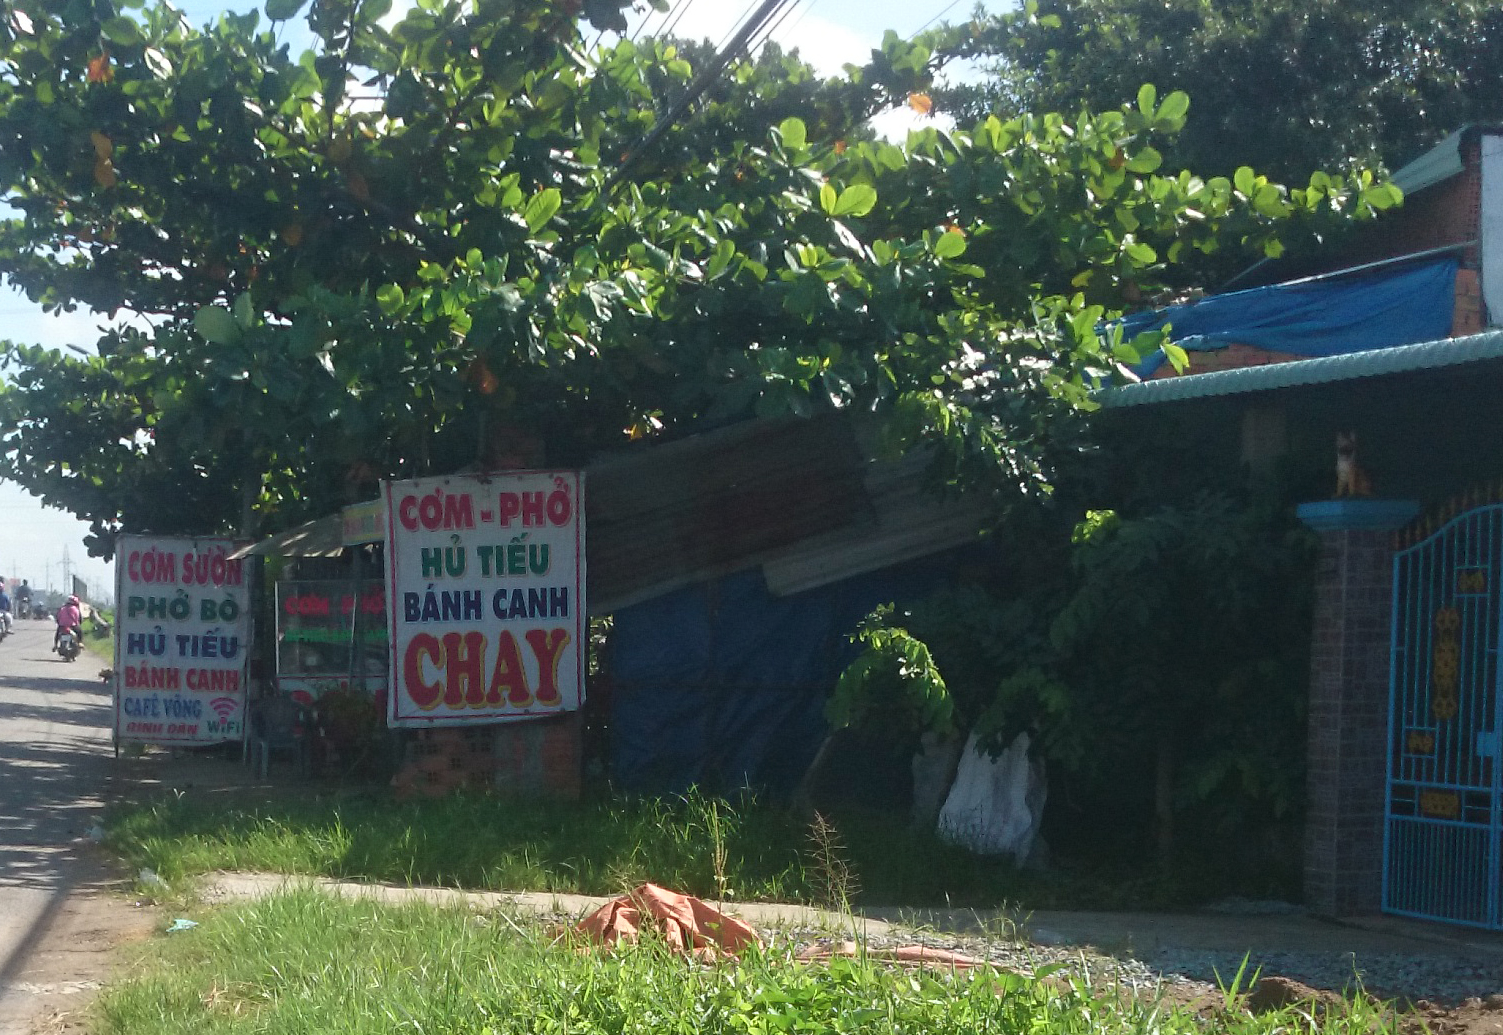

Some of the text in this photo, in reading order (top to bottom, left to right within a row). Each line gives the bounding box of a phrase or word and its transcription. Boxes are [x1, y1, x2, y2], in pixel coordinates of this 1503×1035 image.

[399, 487, 476, 532] CƠM
[500, 476, 572, 528] PHỞ
[128, 545, 176, 584] CƠM
[421, 532, 550, 579] HỦ TIẾU
[128, 588, 239, 622] PHỞ BÒ
[404, 583, 570, 624] BÁNH CANH
[127, 625, 238, 659] HỦ TIẾU
[124, 660, 239, 692] BÁNH CANH
[403, 627, 571, 711] CHAY
